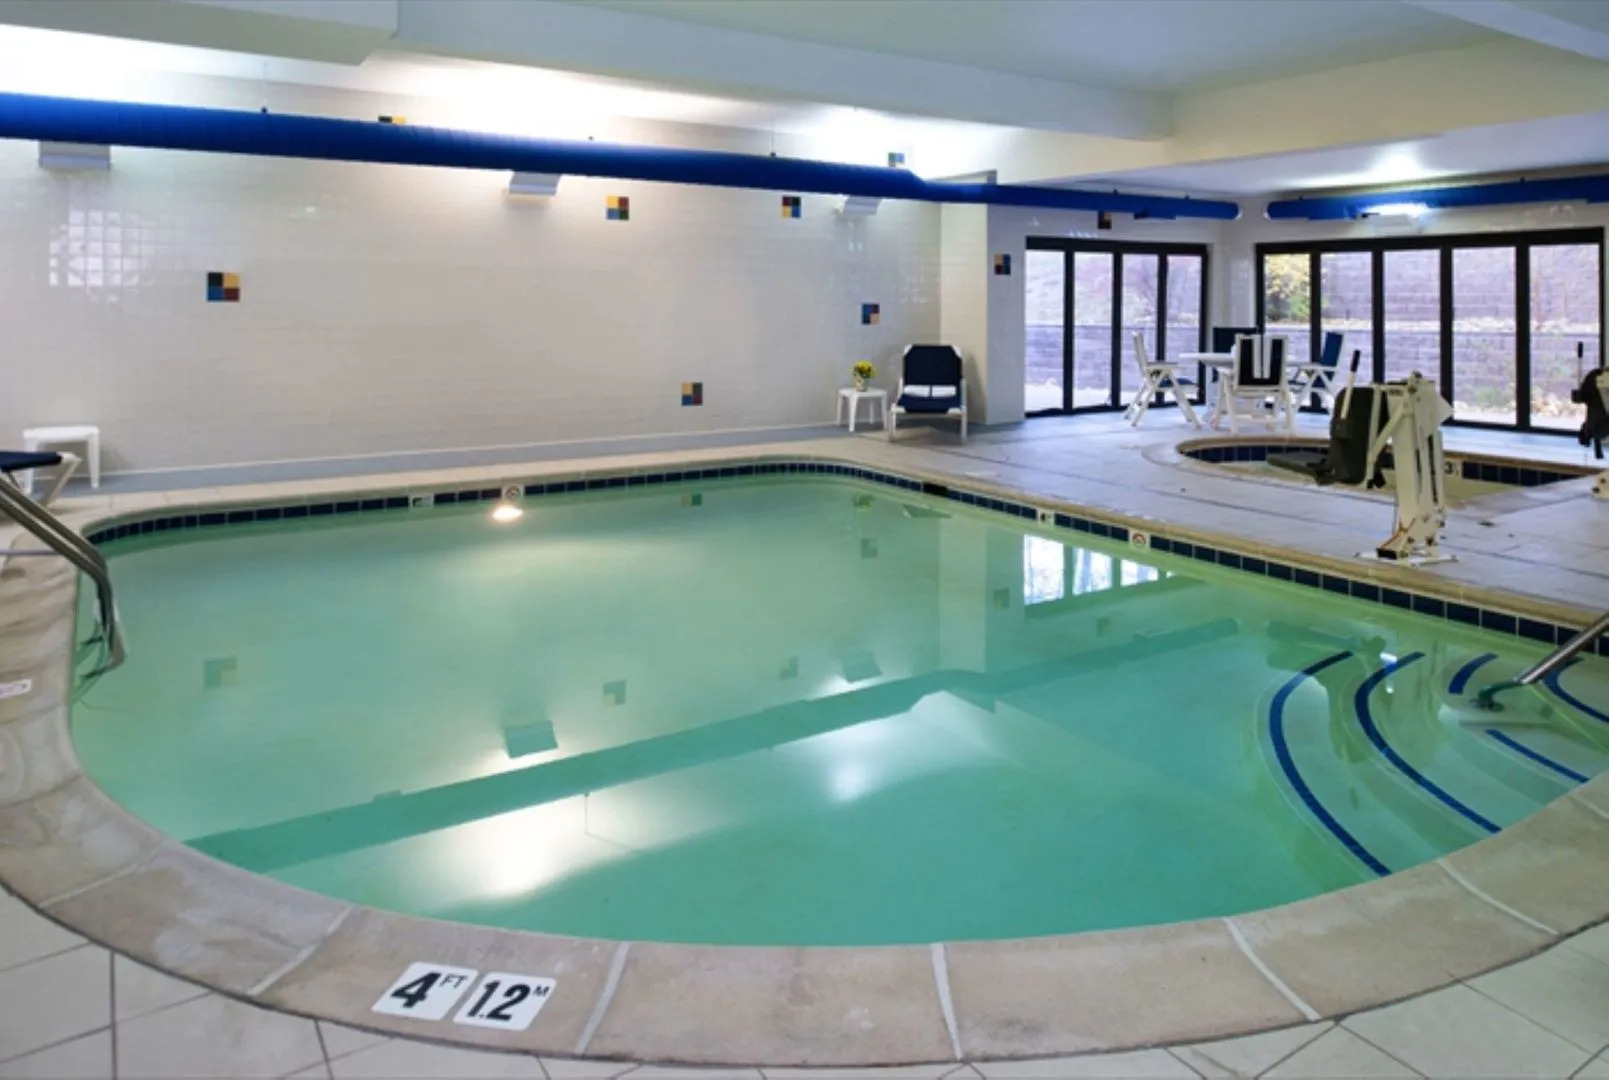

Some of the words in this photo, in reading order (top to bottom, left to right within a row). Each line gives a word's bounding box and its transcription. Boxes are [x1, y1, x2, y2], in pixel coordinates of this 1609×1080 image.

[391, 972, 442, 1008] 4
[440, 974, 467, 989] FT
[534, 985, 550, 996] M
